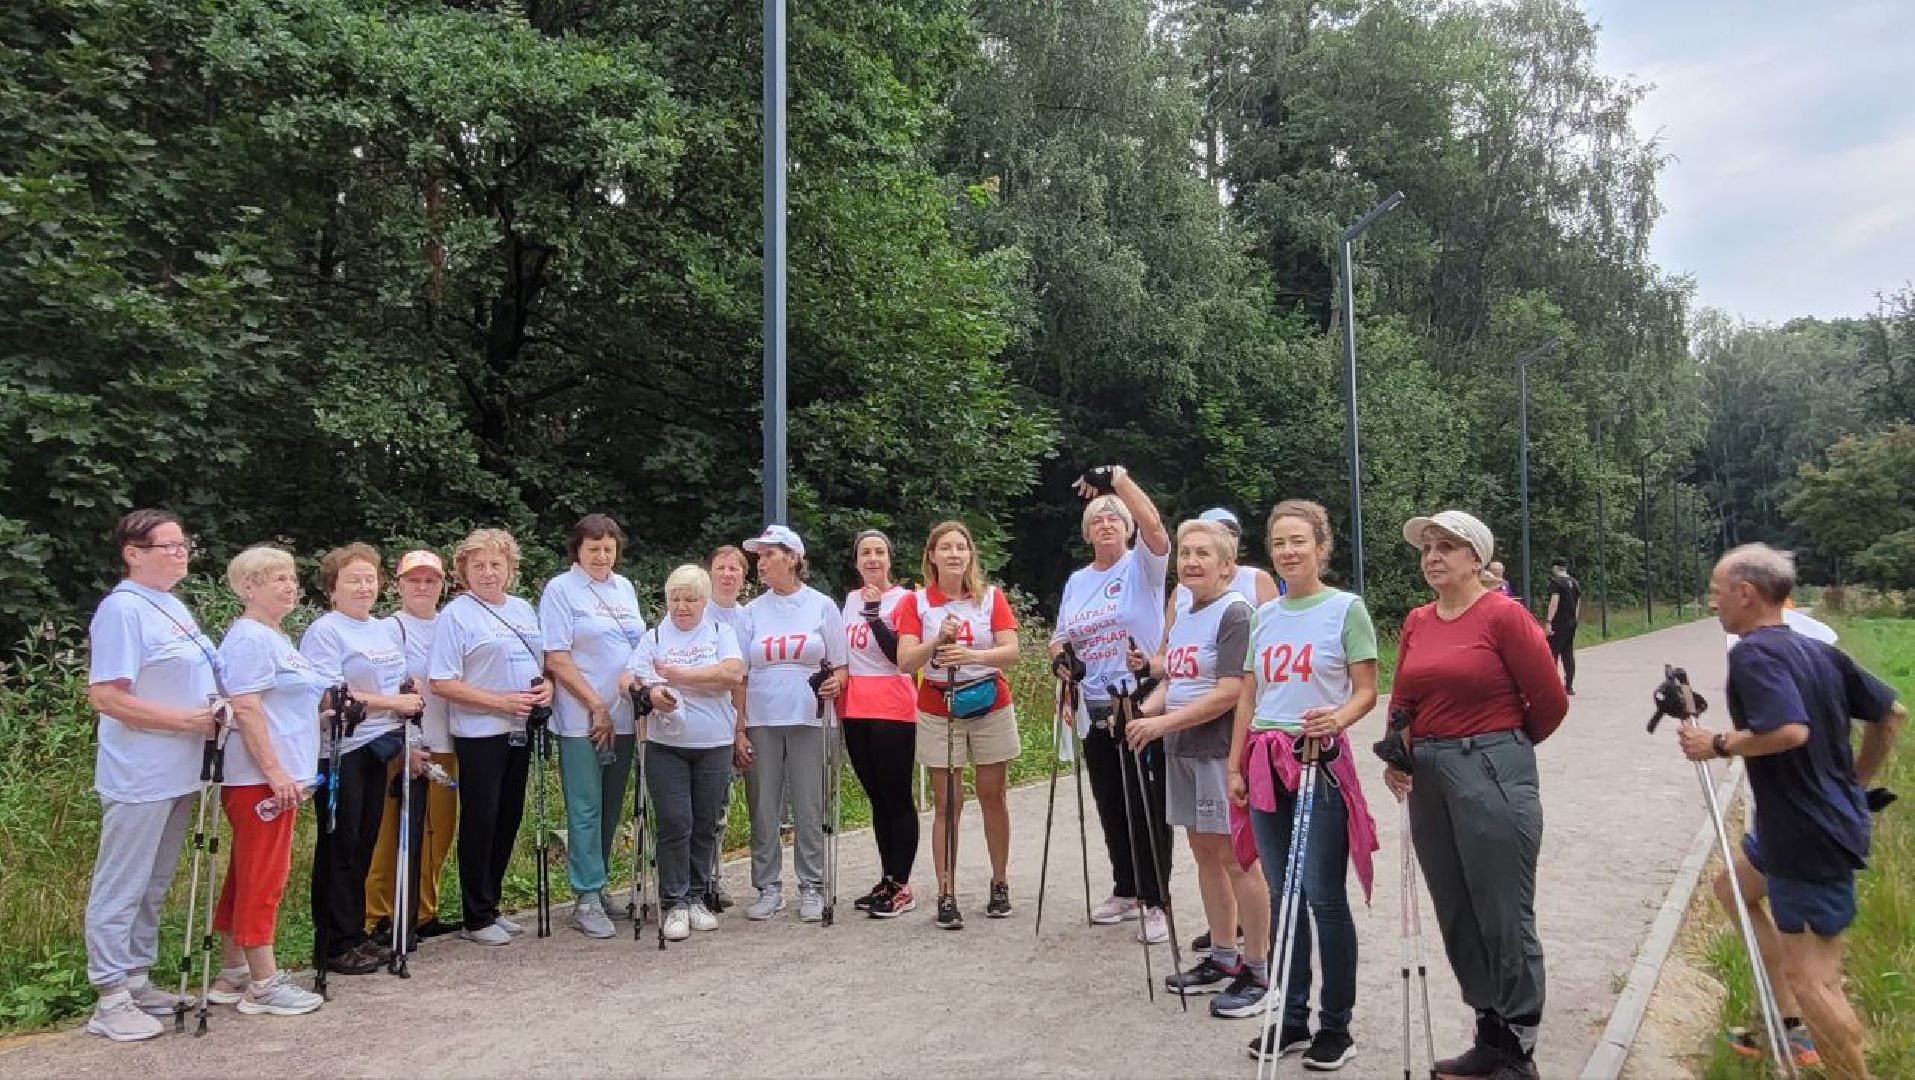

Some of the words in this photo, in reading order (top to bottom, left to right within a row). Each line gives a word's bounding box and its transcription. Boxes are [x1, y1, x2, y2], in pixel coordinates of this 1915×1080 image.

[762, 635, 807, 662] 117
[1167, 646, 1199, 679] 125
[1262, 644, 1313, 683] 124
